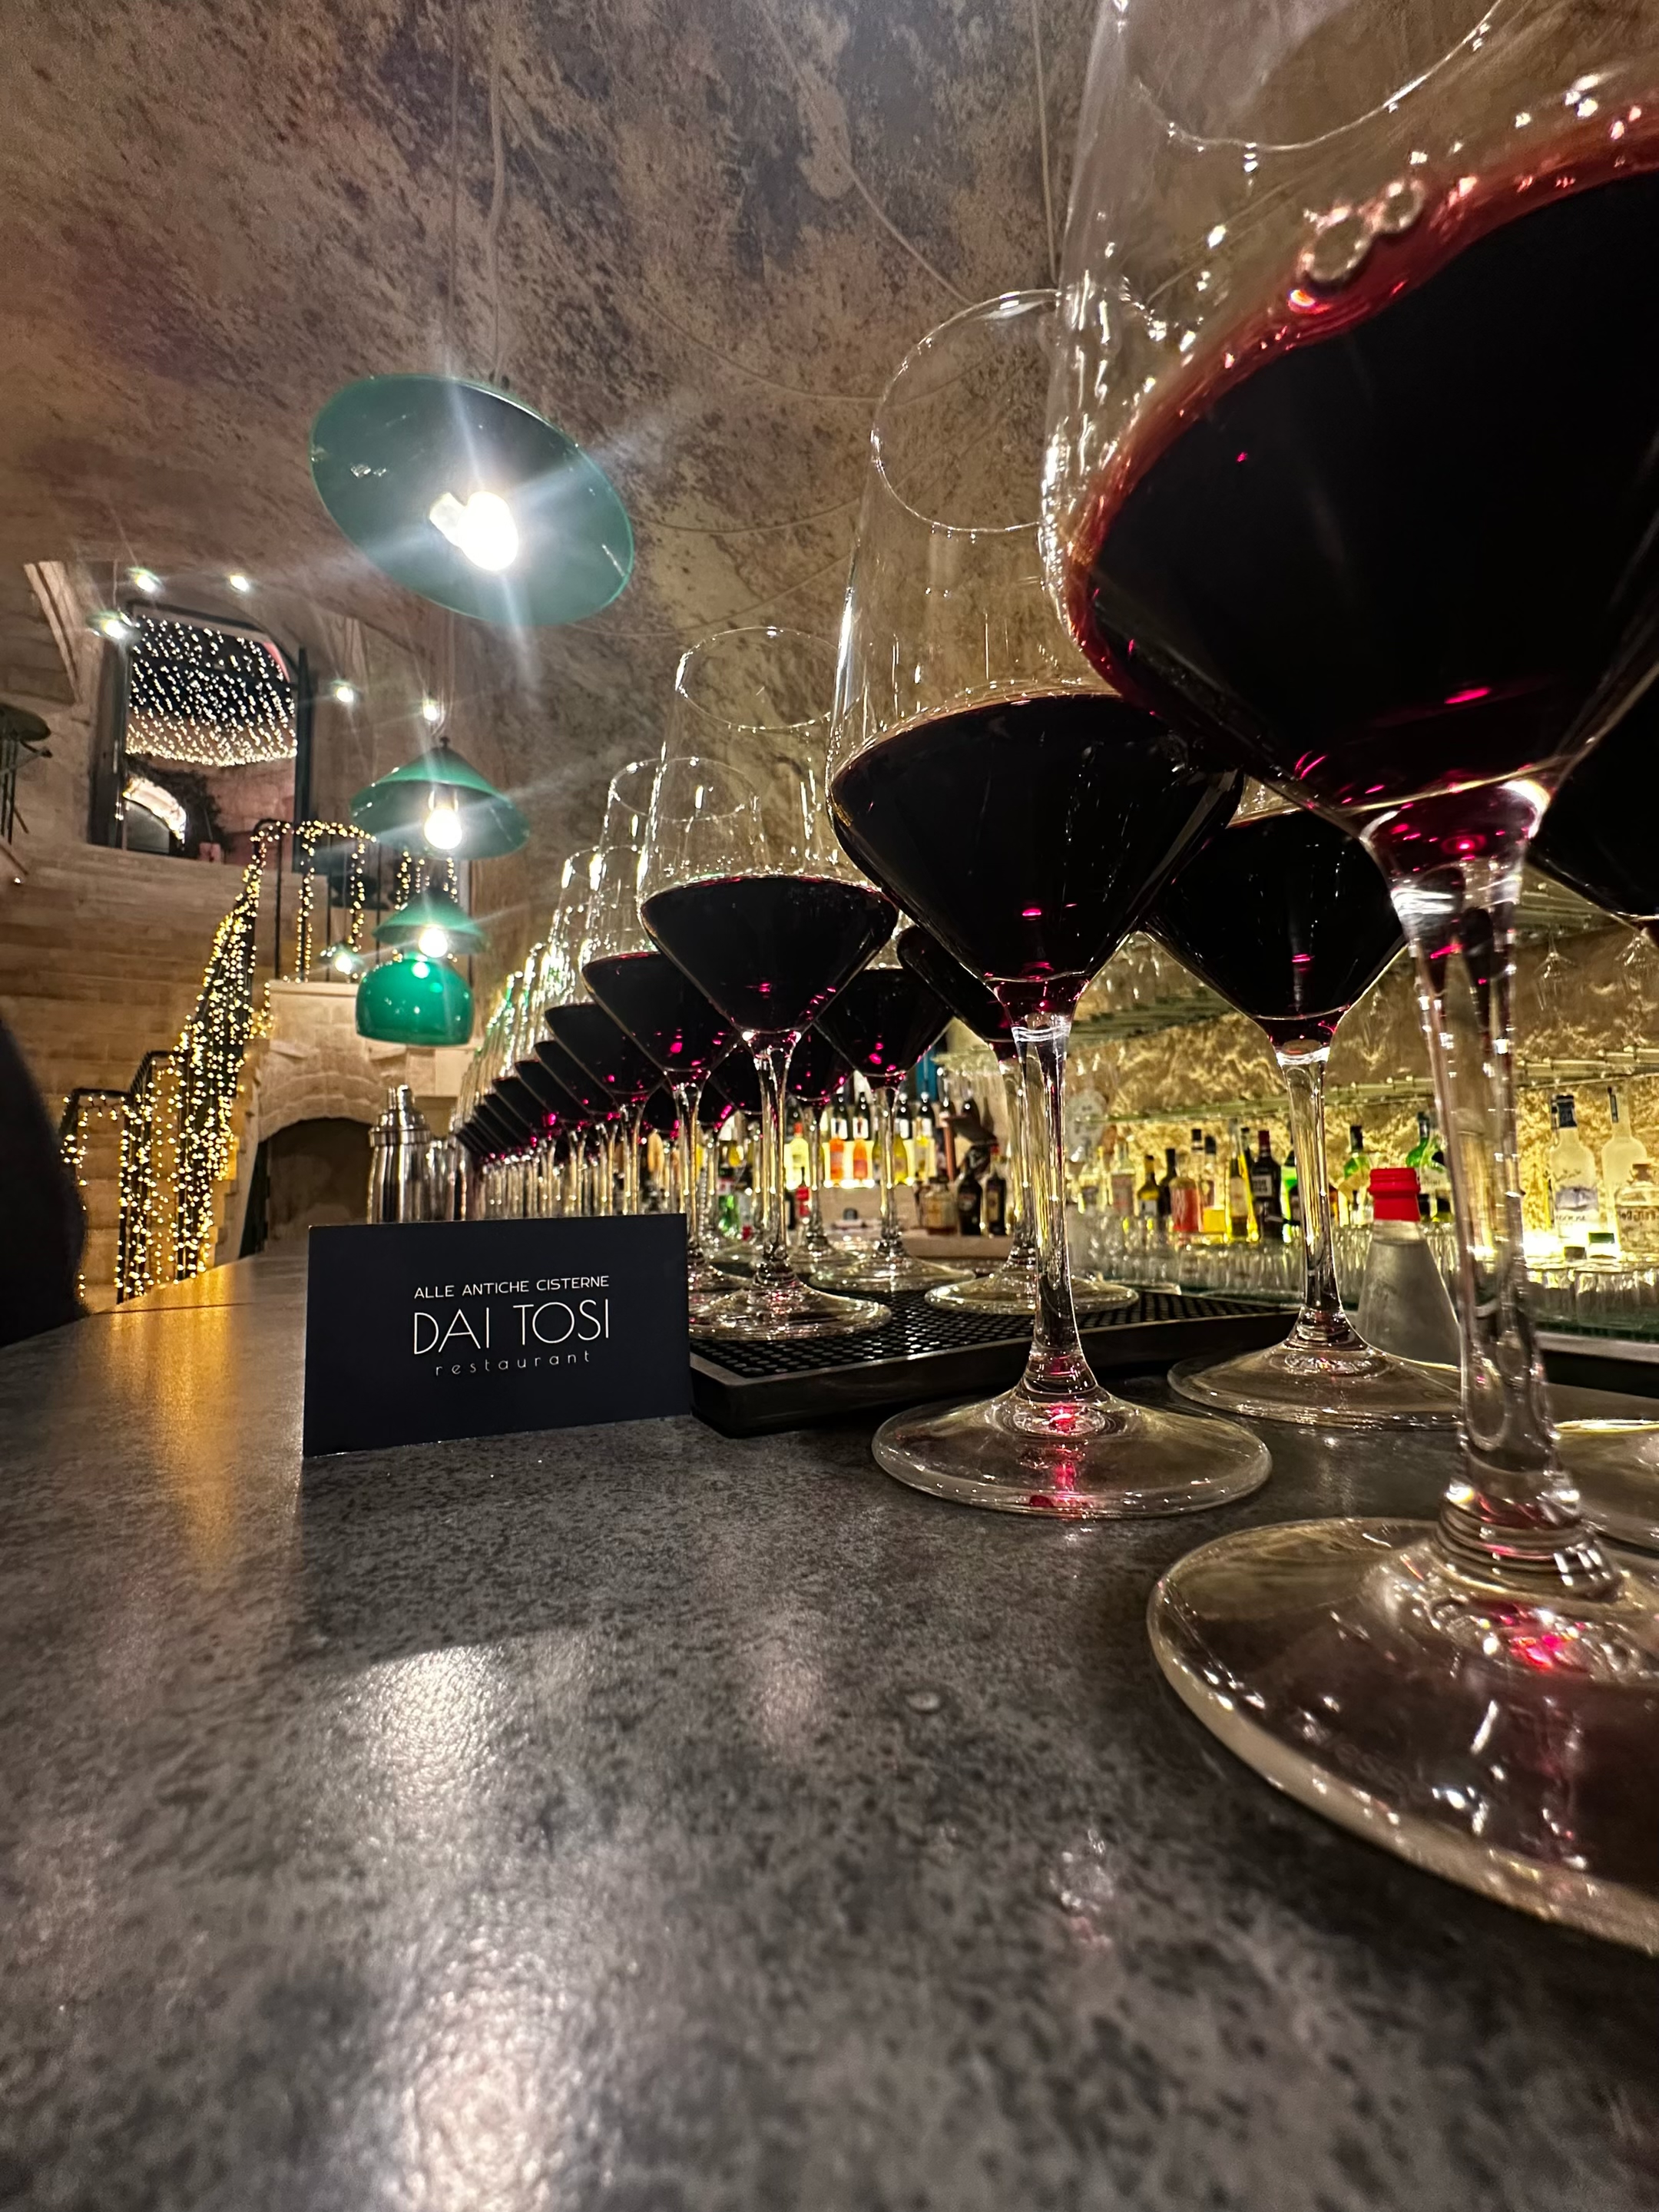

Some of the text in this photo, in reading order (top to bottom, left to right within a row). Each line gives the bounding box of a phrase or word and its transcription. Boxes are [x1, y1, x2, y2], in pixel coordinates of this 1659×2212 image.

[414, 1276, 610, 1300] ALLE ANTICHE CISTERNE
[413, 1298, 609, 1355] DAI TOSI
[435, 1350, 590, 1376] restaurant
